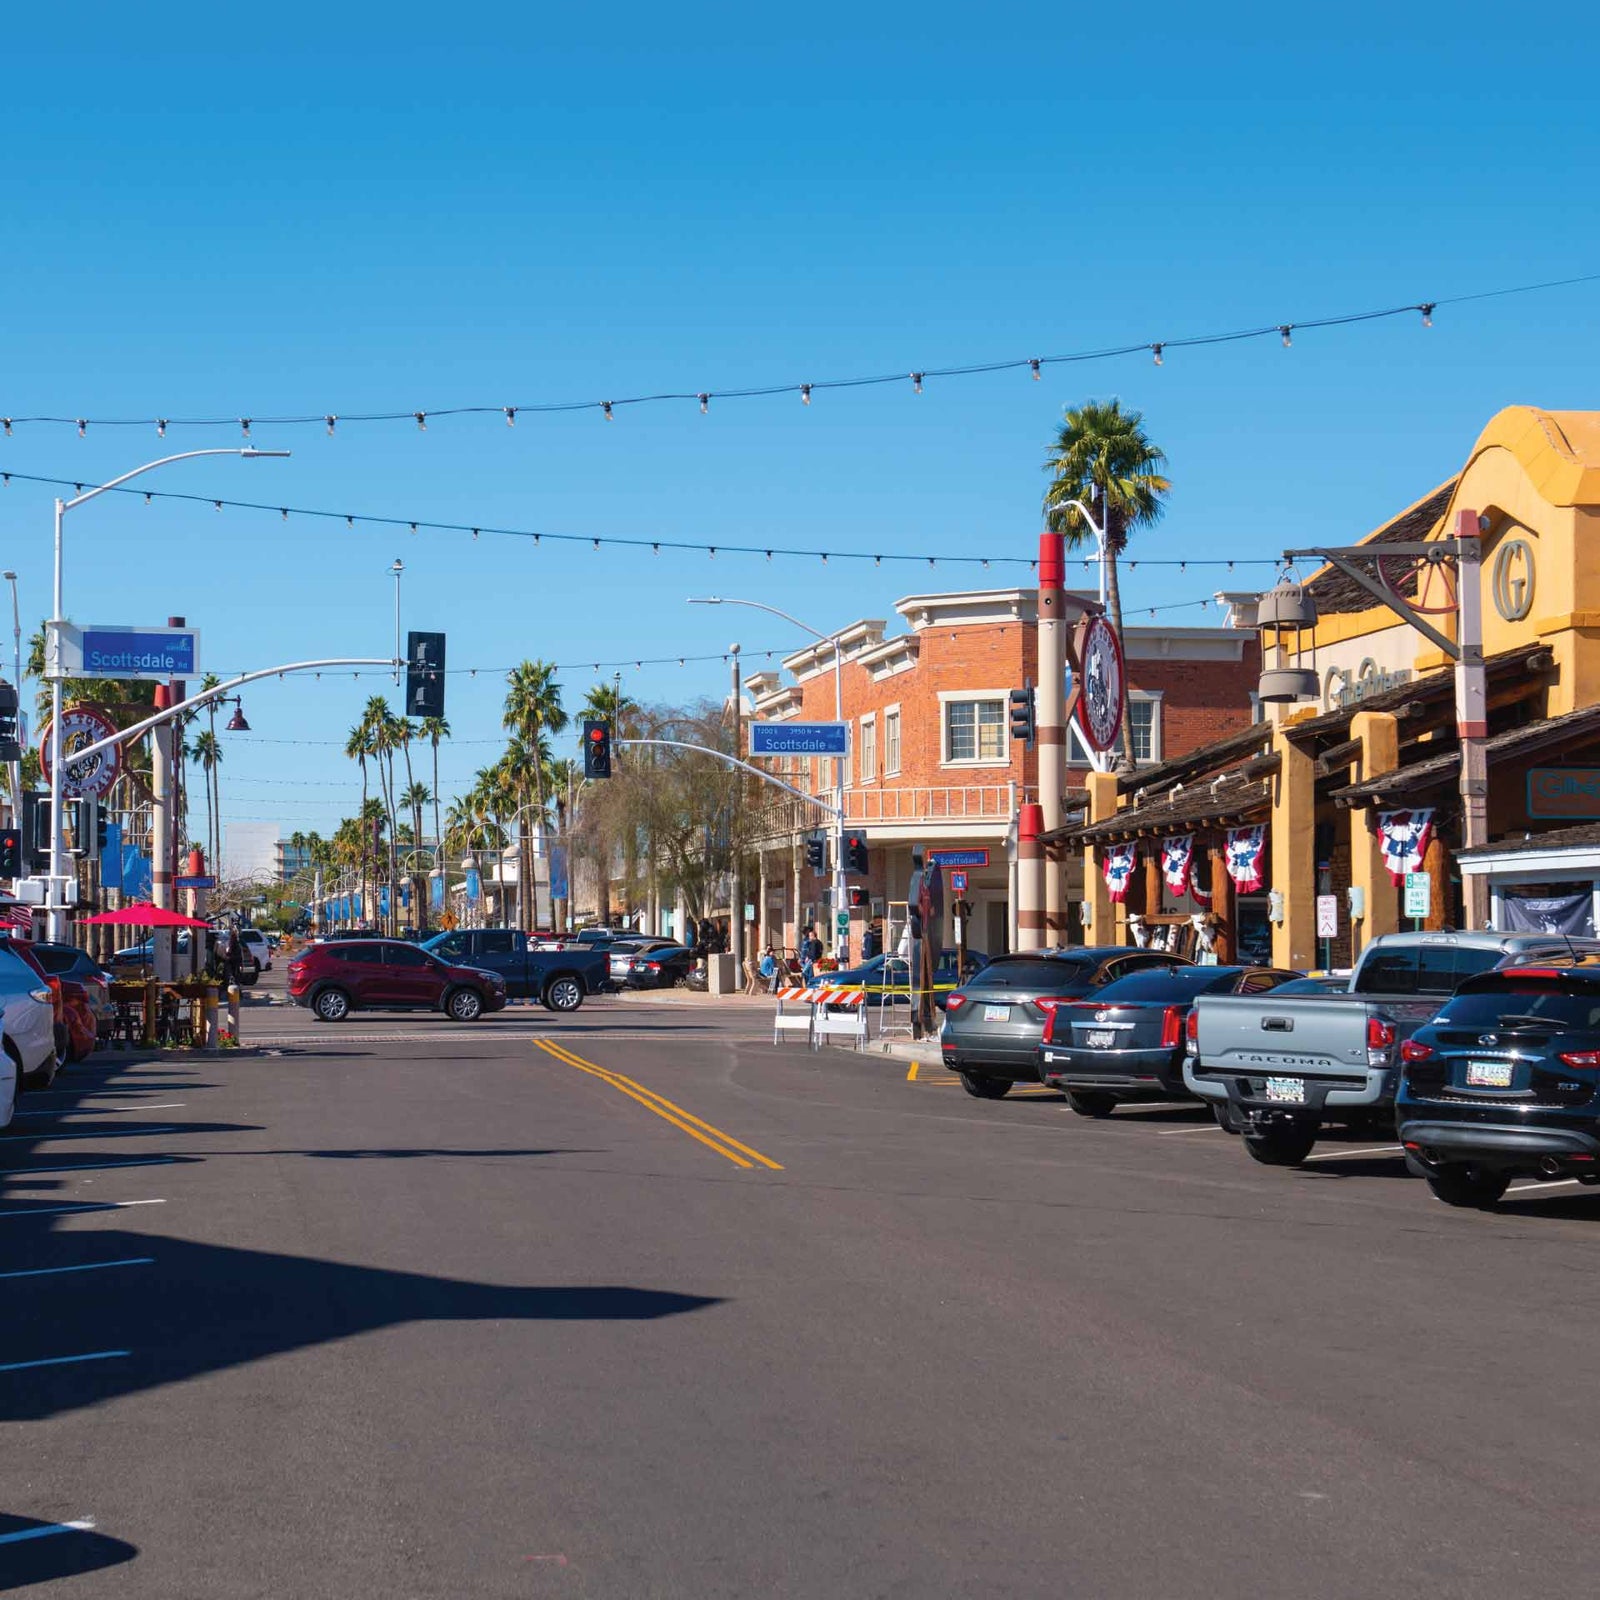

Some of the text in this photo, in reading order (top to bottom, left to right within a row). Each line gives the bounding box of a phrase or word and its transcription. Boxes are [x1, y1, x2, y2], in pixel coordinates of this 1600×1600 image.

[91, 650, 174, 669] Scottsdale
[766, 738, 827, 750] Scottsdale
[939, 857, 978, 866] Scottsdale
[1409, 899, 1425, 907] TIME
[1237, 1054, 1332, 1066] TACOMA
